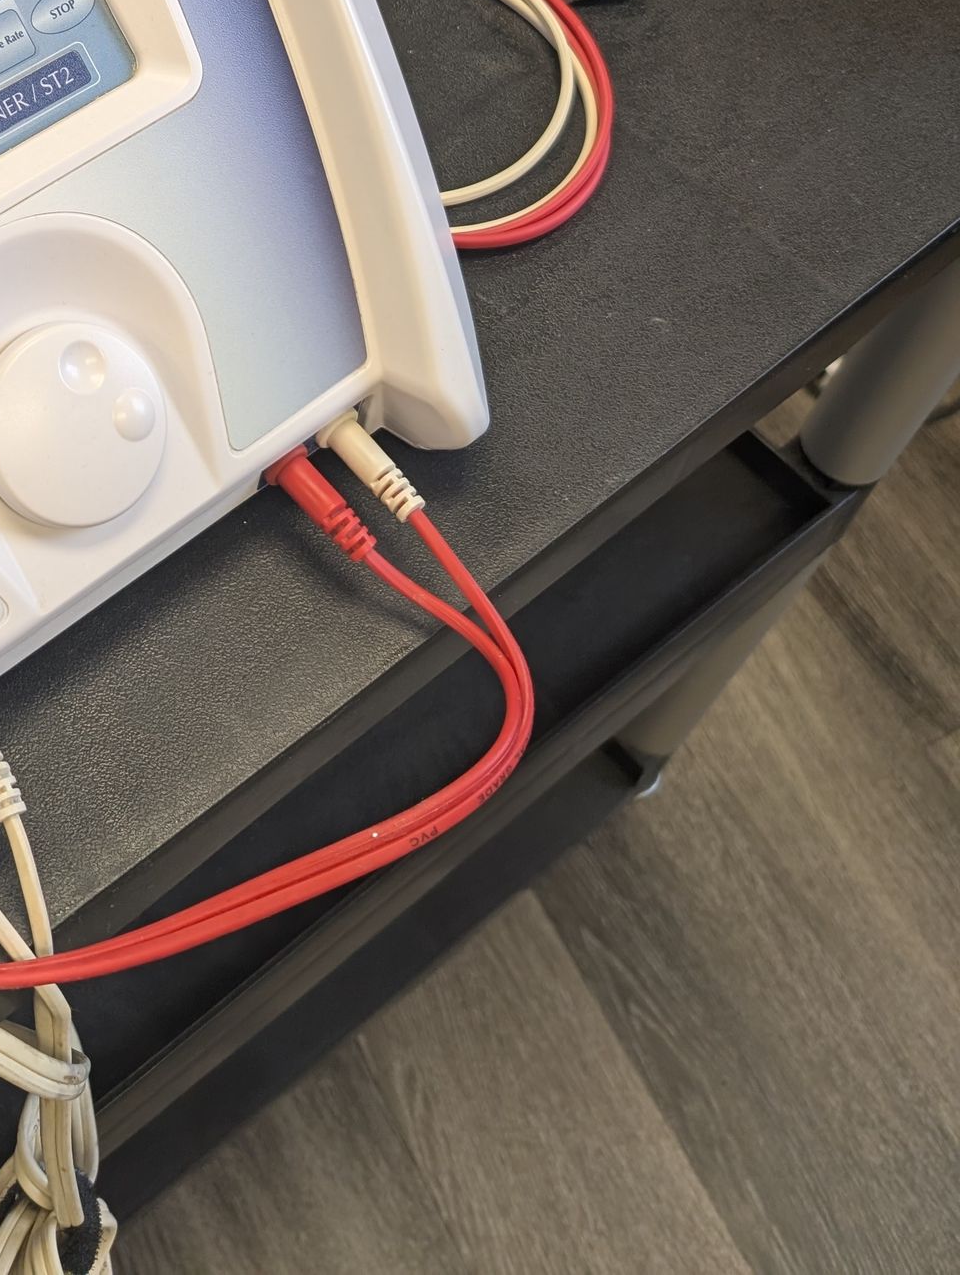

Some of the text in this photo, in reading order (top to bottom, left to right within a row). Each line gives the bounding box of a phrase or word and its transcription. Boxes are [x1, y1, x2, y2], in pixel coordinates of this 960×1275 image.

[50, 0, 76, 20] STOP
[4, 30, 25, 46] Rate
[40, 66, 74, 96] ST2
